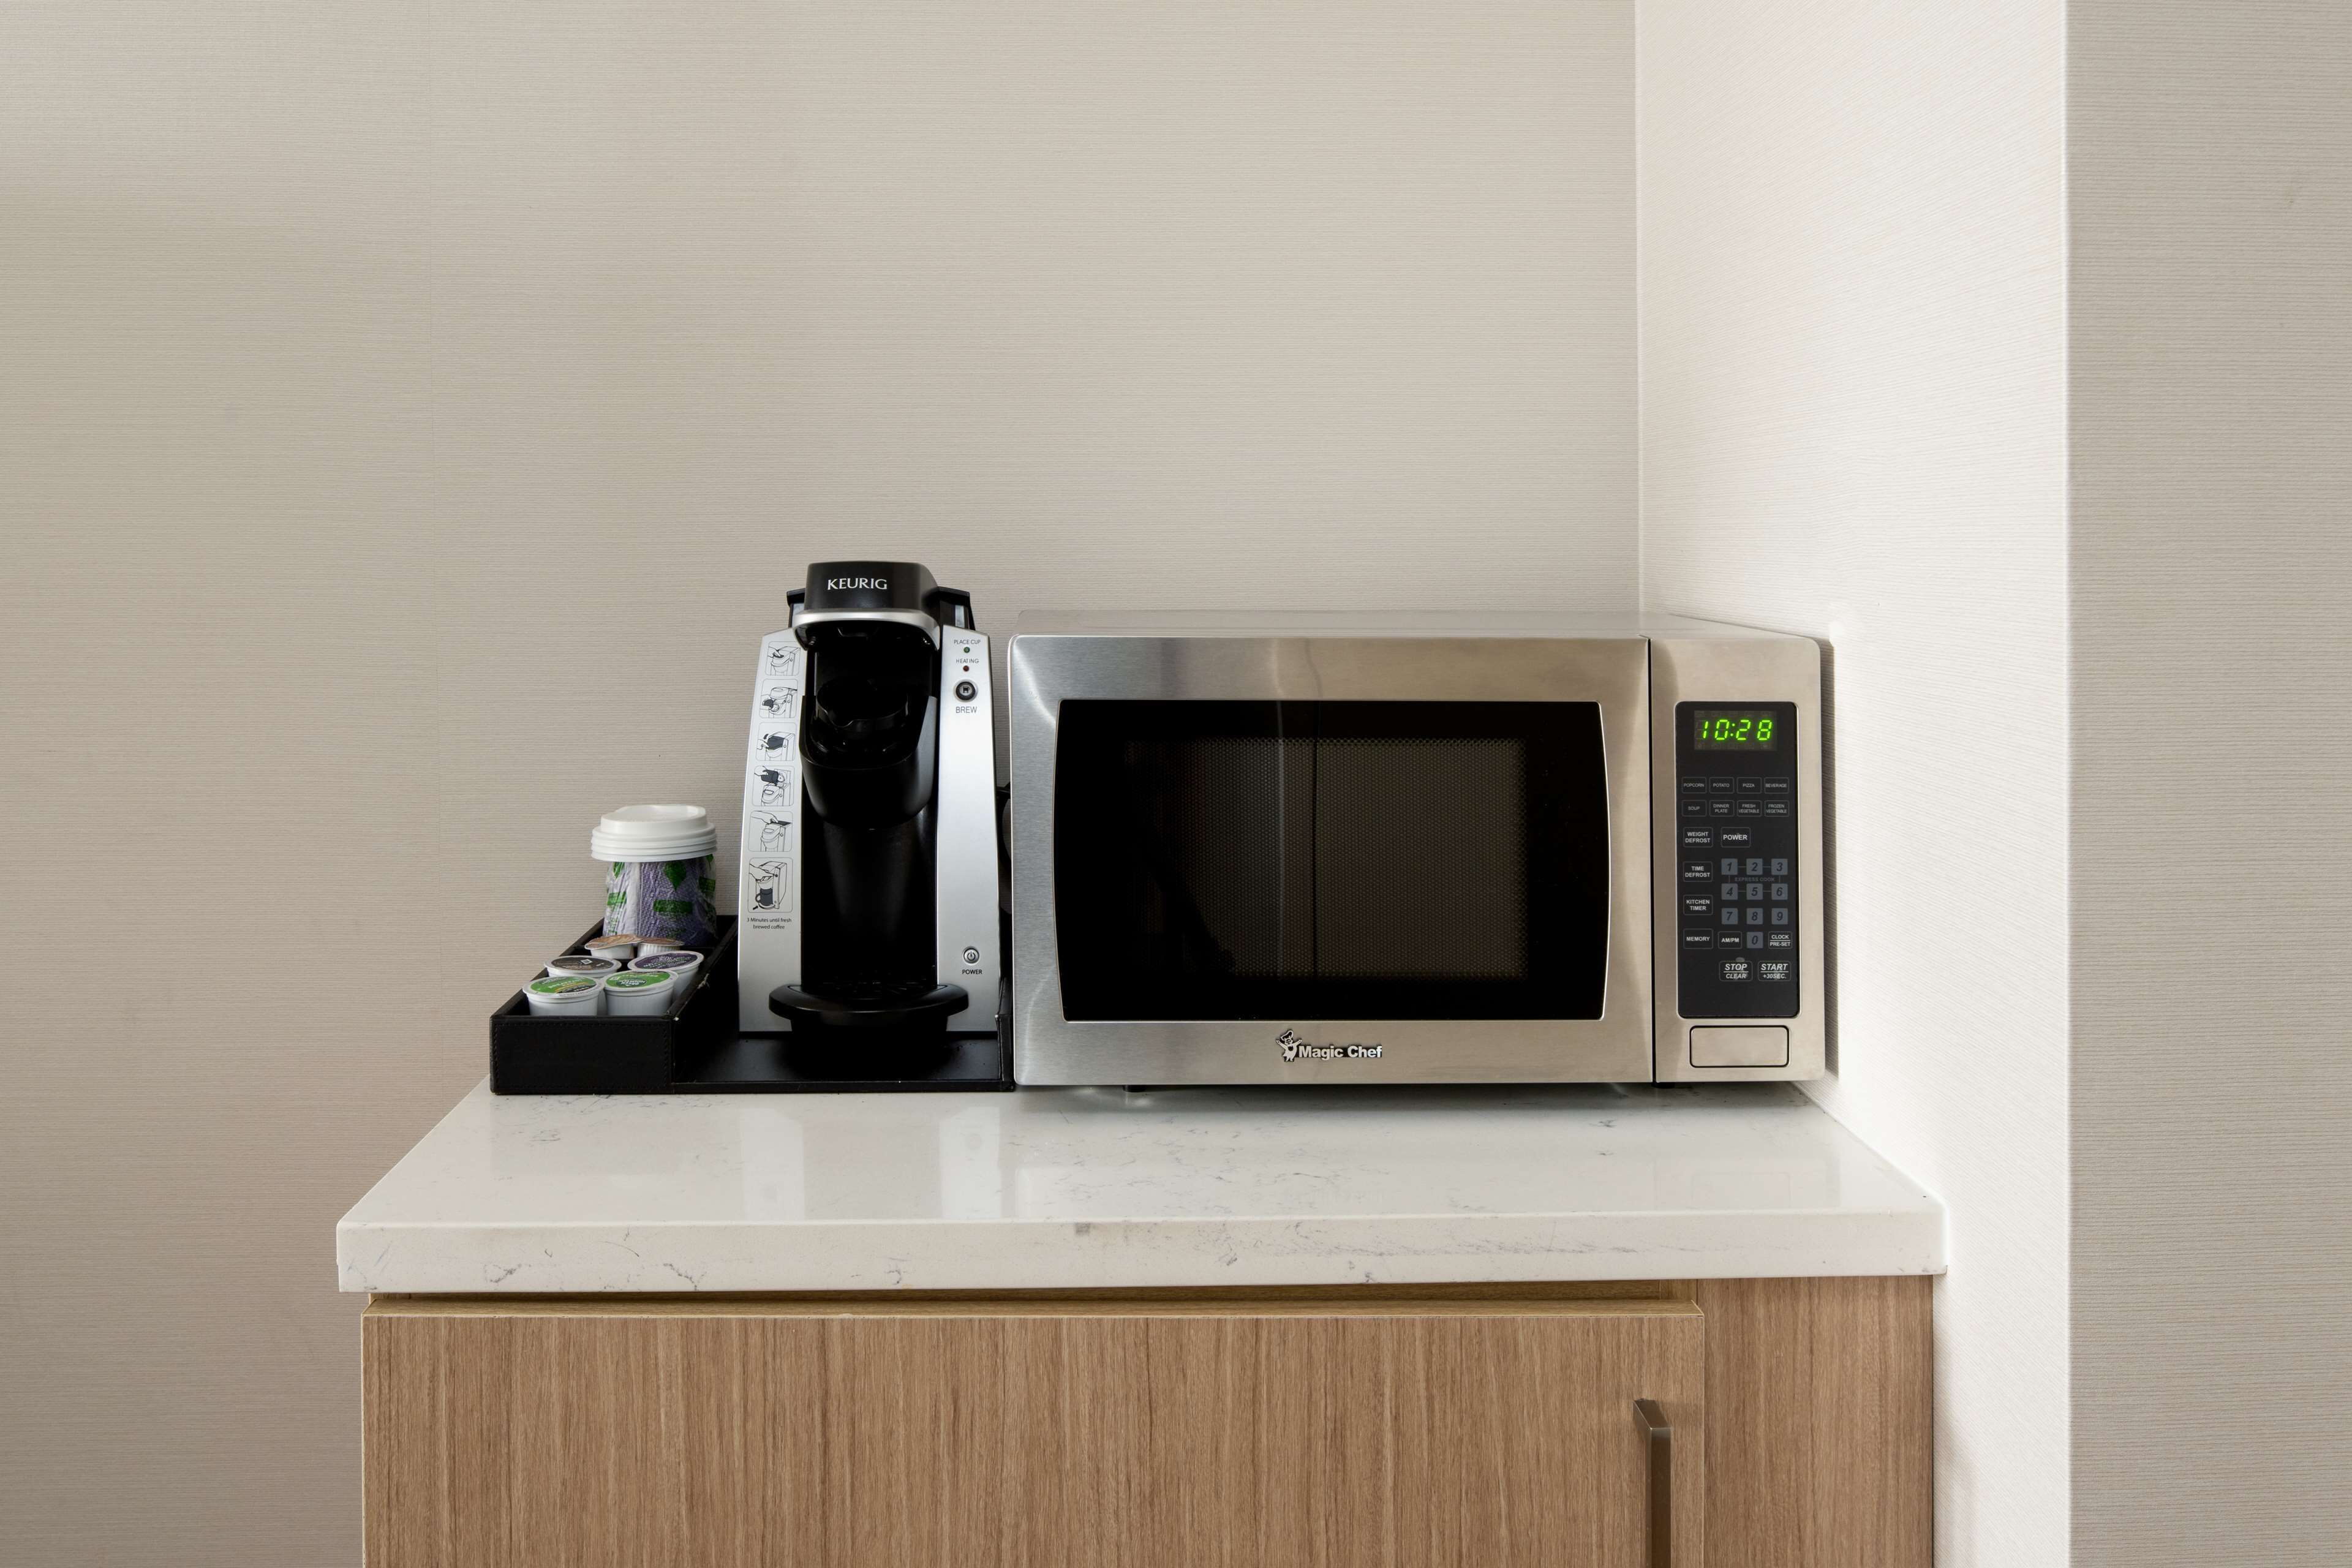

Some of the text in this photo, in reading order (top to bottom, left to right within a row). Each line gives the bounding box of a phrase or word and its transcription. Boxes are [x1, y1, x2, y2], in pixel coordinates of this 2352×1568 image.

[827, 578, 888, 590] KEURIG
[1703, 719, 1773, 741] 10:28
[1727, 862, 1732, 871] 1
[1751, 862, 1757, 871] 2
[1776, 862, 1783, 871] 3
[1727, 888, 1733, 896] 4
[1751, 888, 1757, 896] 5
[1777, 888, 1782, 896] 6
[1727, 912, 1733, 921] 7
[1752, 912, 1757, 921] 8
[1777, 912, 1782, 921] 9
[1752, 936, 1757, 944] 0
[1298, 1045, 1382, 1060] Magic Chef
